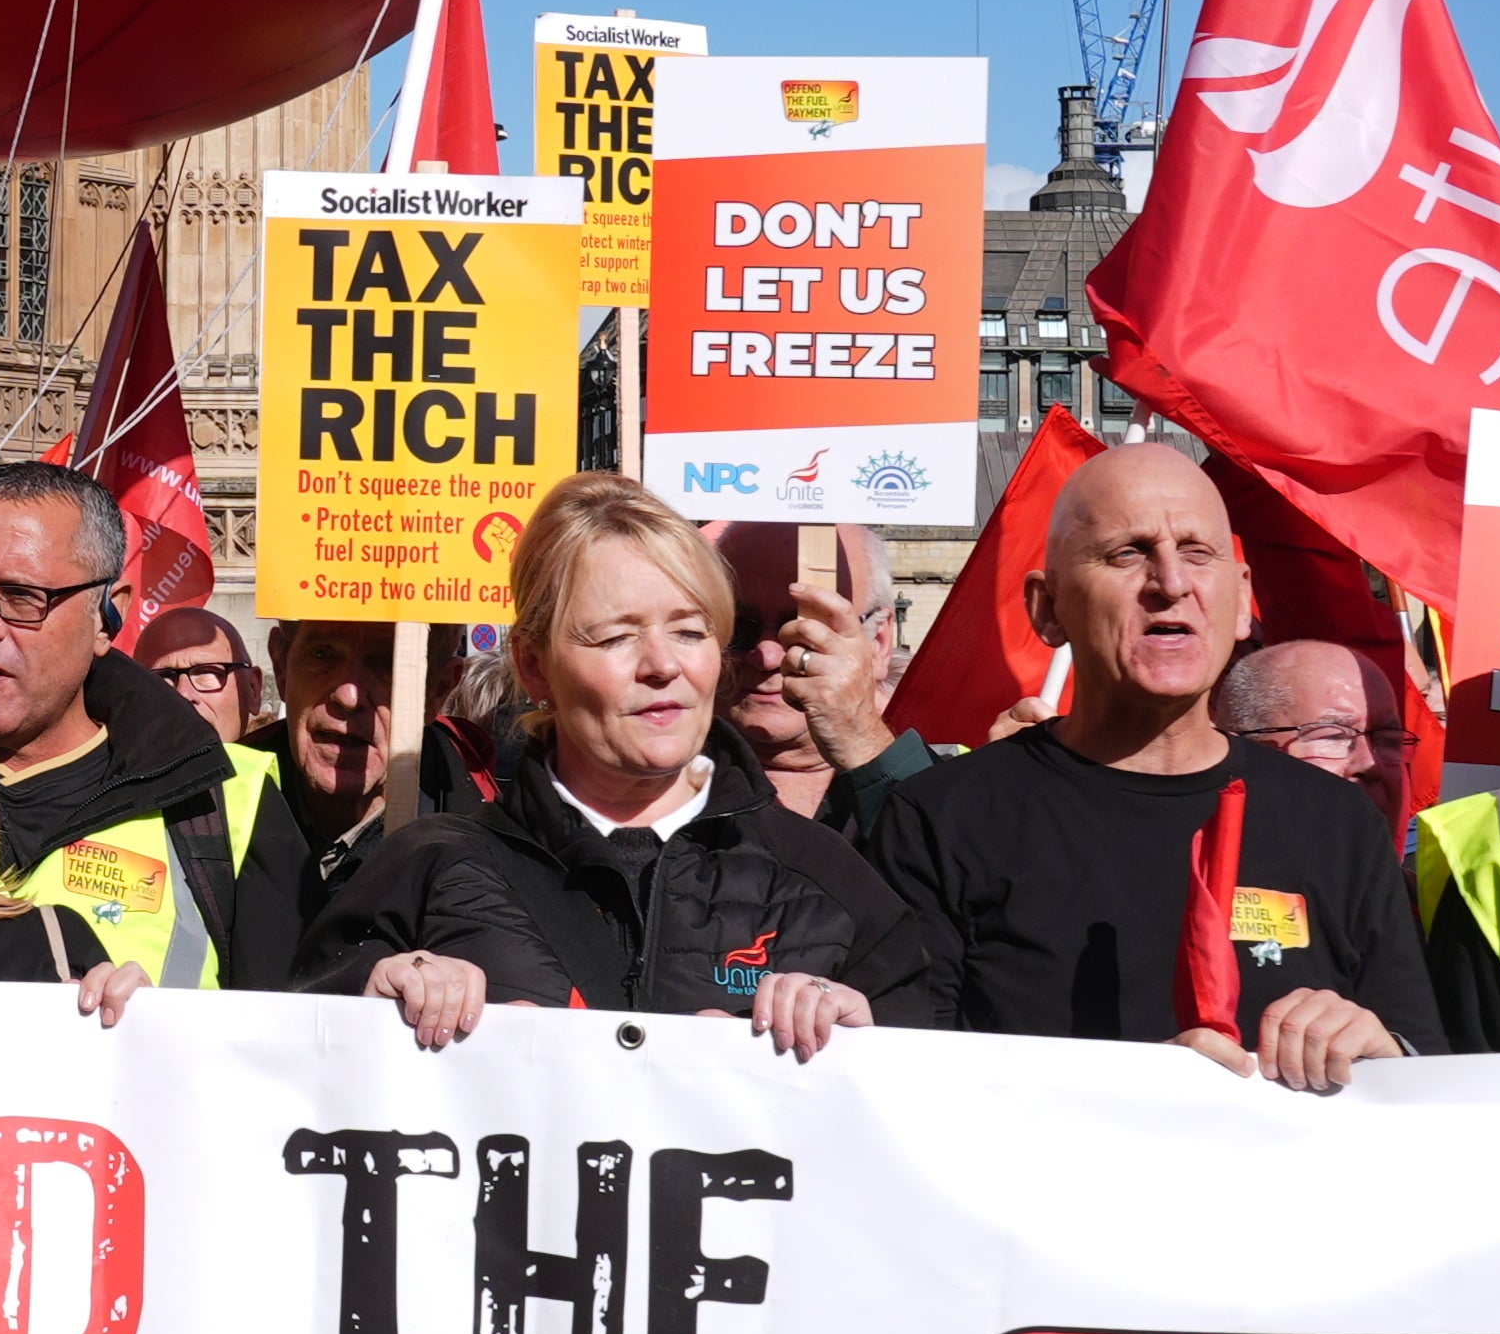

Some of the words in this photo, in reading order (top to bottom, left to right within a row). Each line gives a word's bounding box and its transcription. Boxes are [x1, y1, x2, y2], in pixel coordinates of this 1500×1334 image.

[566, 24, 631, 45] Socialist
[631, 28, 681, 49] Worker
[555, 50, 655, 103] TAX
[555, 101, 653, 154] THE
[558, 153, 651, 205] RIC
[320, 188, 433, 217] Socialist
[434, 190, 528, 219] Worker
[592, 214, 639, 230] squeeze
[713, 199, 923, 250] DON'T
[617, 234, 651, 251] winter
[298, 229, 485, 306] TAX
[594, 253, 639, 272] support
[605, 279, 626, 294] two
[705, 267, 823, 316] LET
[837, 267, 927, 316] US
[297, 308, 477, 385] THE
[691, 330, 937, 381] FREEZE
[298, 387, 537, 466] RICH
[298, 469, 353, 497] Don't
[357, 473, 445, 502] squeeze
[449, 473, 485, 499] the
[488, 477, 536, 505] poor
[684, 462, 760, 494] NPC
[776, 484, 824, 502] unite
[315, 507, 395, 537] Protect
[400, 512, 465, 537] winter
[314, 537, 354, 565] fuel
[359, 541, 440, 569] support
[313, 576, 376, 608] Scrap
[381, 579, 419, 603] two
[423, 577, 472, 604] child
[68, 844, 118, 864] DEFEND
[68, 858, 94, 874] THE
[96, 864, 125, 883] FUEL
[68, 874, 127, 899] PAYMENT
[1245, 907, 1272, 921] FUEL
